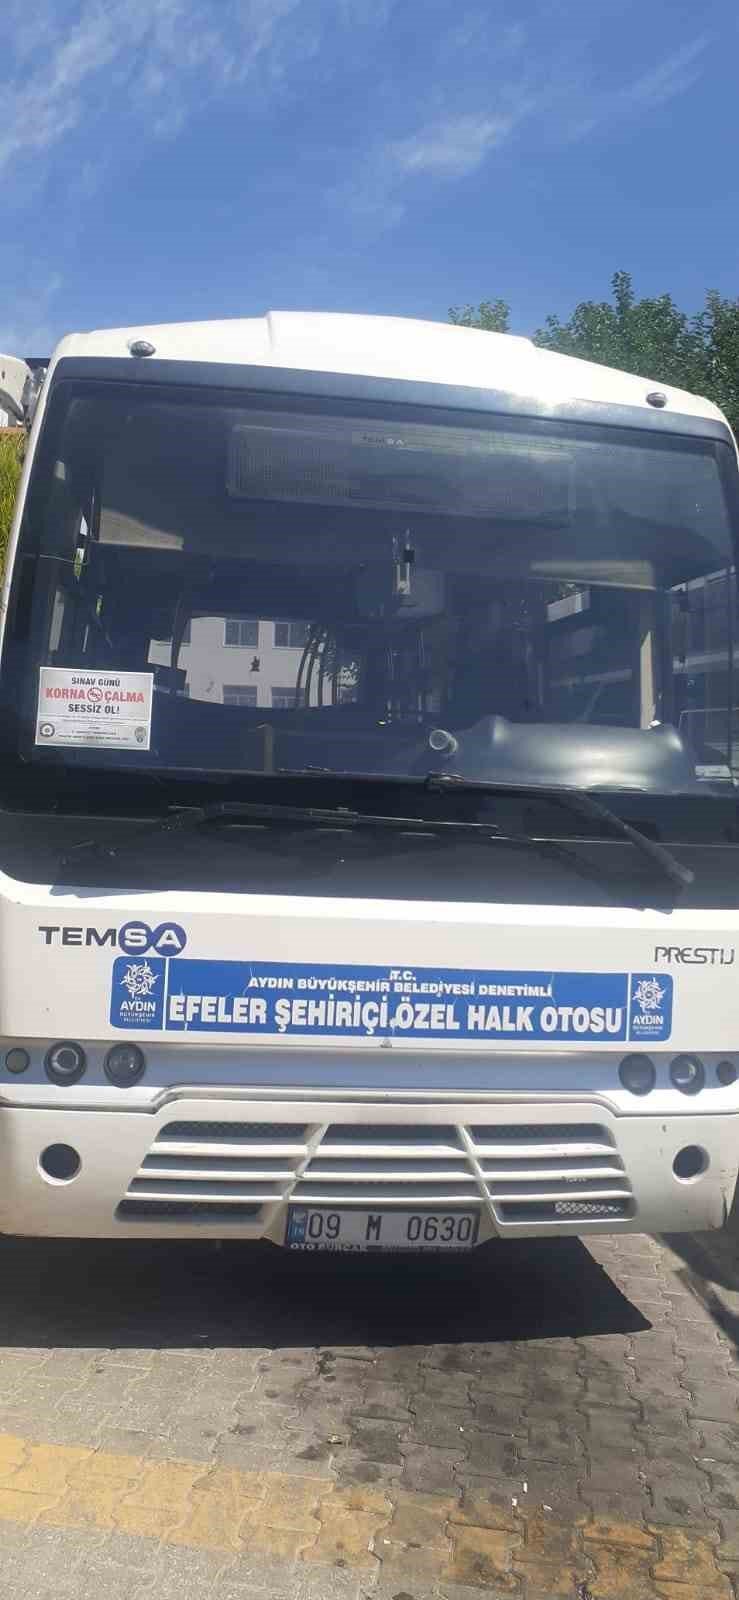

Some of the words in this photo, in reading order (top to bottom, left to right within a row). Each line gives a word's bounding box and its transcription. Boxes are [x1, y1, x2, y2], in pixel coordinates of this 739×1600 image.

[71, 677, 96, 686] SINAV
[45, 687, 86, 700] KORNA
[104, 690, 145, 704] ÇALMA
[68, 702, 101, 714] SESSİZ
[104, 705, 120, 715] OL!
[38, 923, 185, 953] TEMSA
[391, 970, 417, 981] T.C.
[248, 977, 294, 989] AYDIN
[297, 976, 391, 993] BÜYÜKŞEHİR
[394, 981, 475, 996] BELEDİYESİ
[478, 983, 553, 998] DENETİMLİ
[120, 1000, 156, 1012] AYDIN
[169, 995, 267, 1025] EFELER
[274, 994, 389, 1035] ŞEHİRİÇİ
[395, 996, 461, 1030] ÖZEL
[467, 1005, 534, 1032] HALK
[540, 1006, 622, 1034] OTOSU
[633, 1015, 664, 1025] AYDIN
[308, 1212, 342, 1240] 09
[365, 1214, 383, 1241] M
[406, 1215, 473, 1242] 0630
